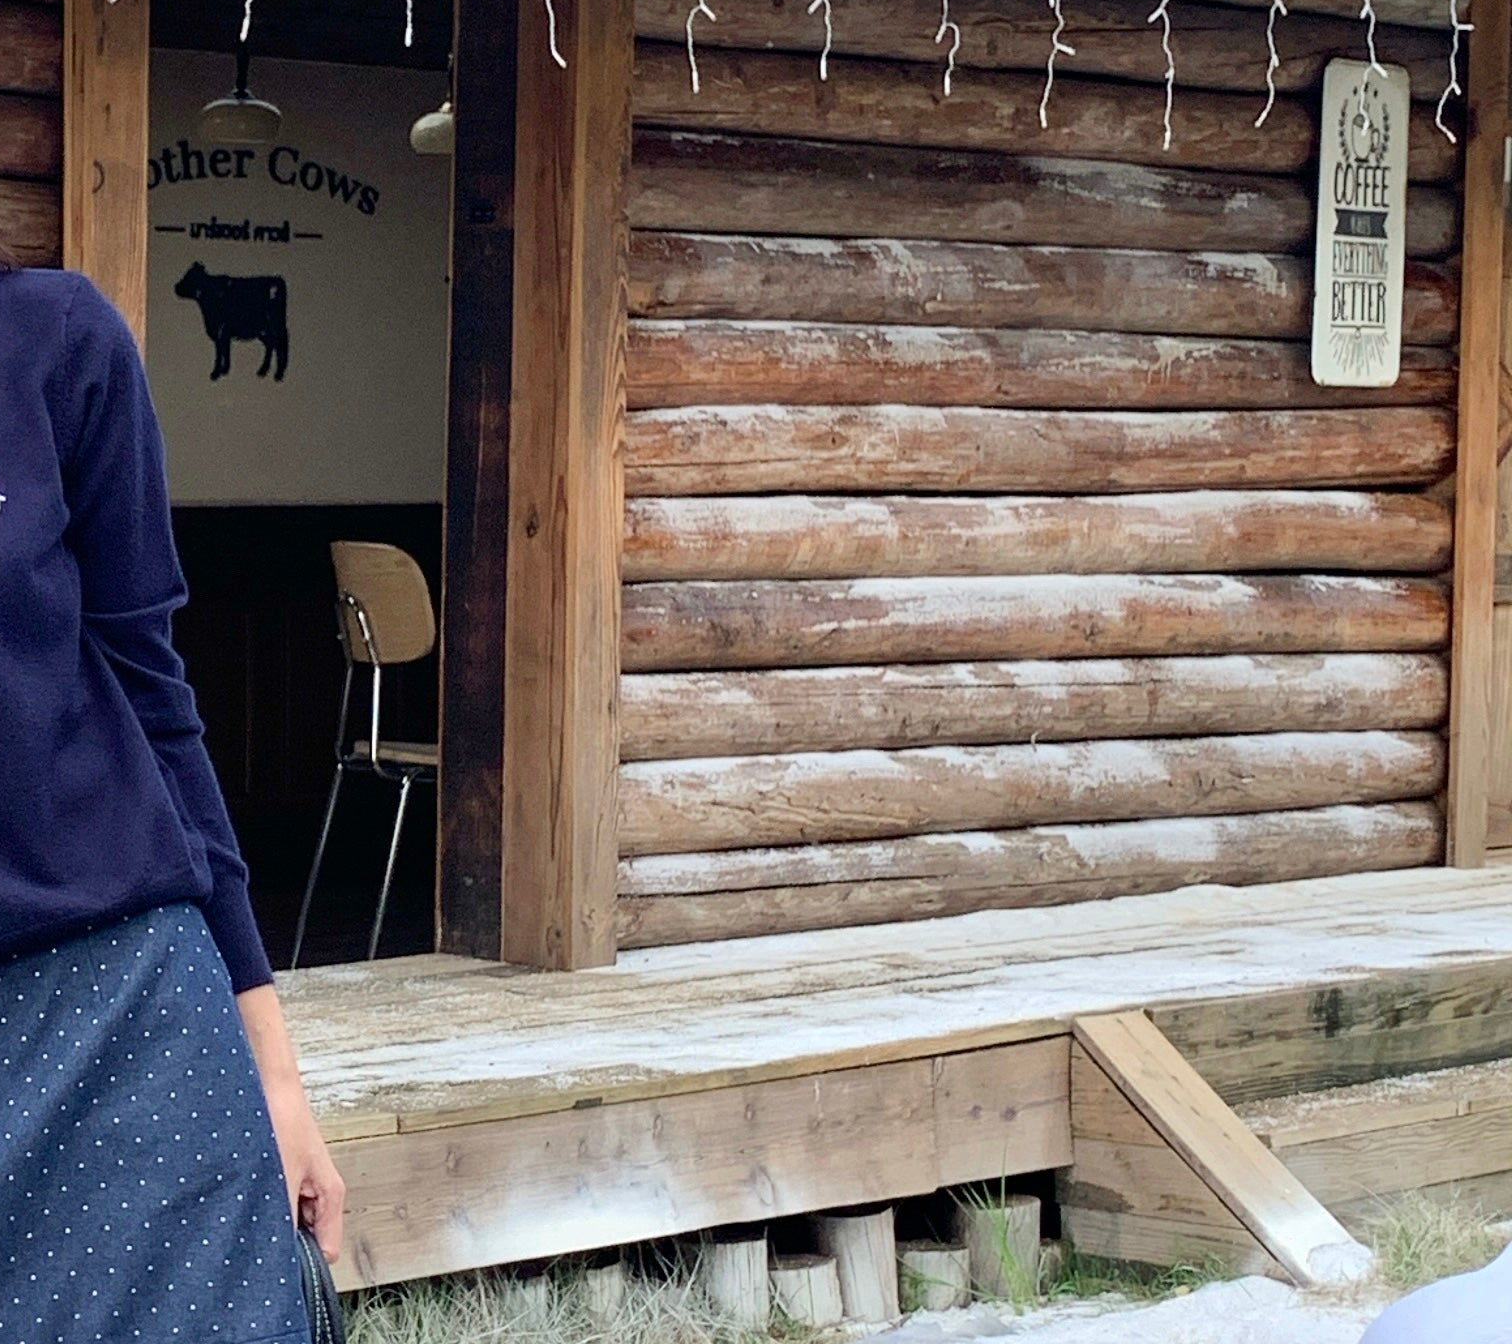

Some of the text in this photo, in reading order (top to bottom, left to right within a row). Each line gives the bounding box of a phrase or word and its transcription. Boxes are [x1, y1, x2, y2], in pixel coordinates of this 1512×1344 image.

[268, 145, 380, 216] Cows
[1333, 162, 1391, 208] COFFEE
[1331, 280, 1387, 324] BETTER
